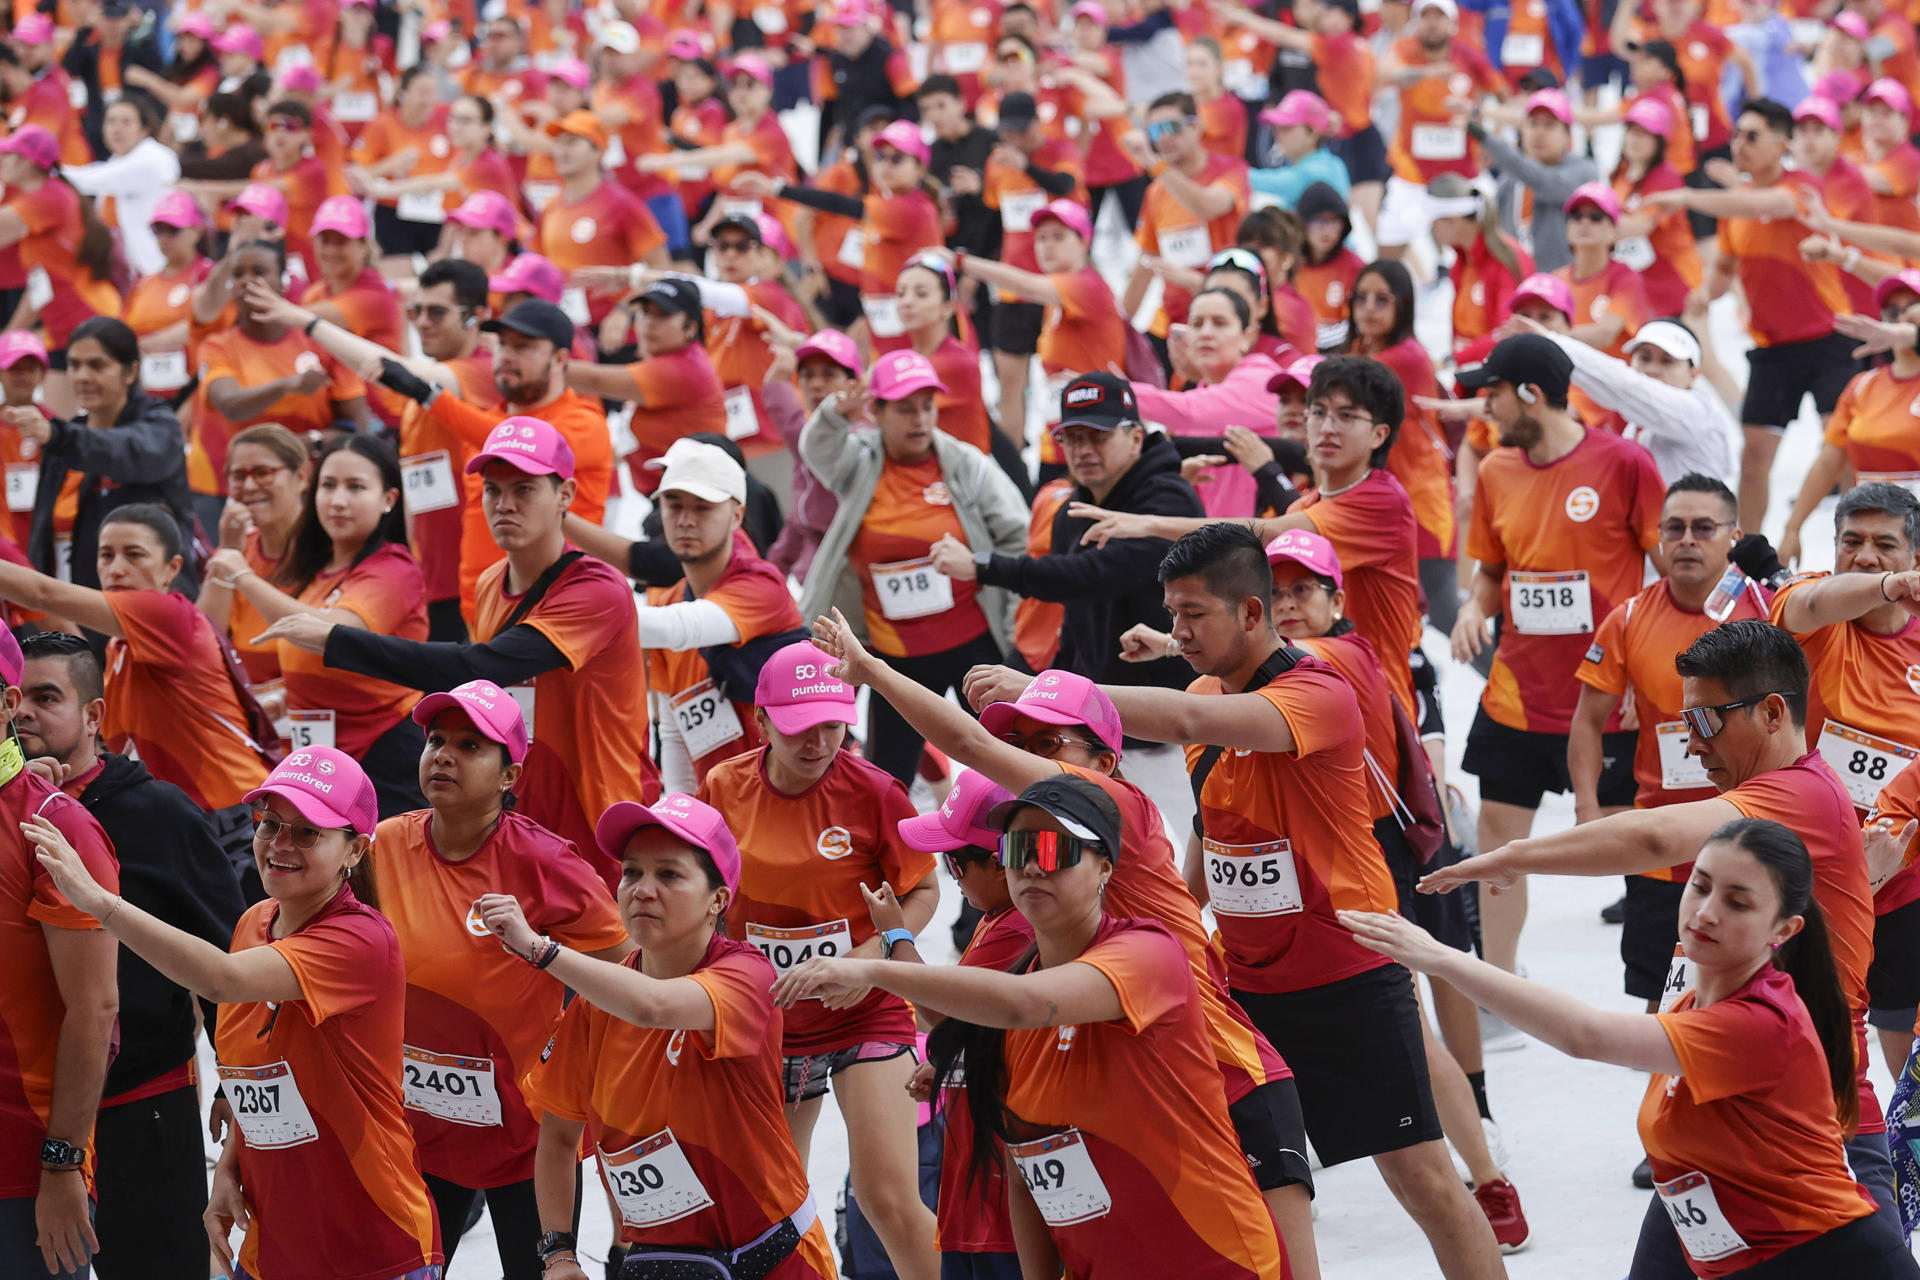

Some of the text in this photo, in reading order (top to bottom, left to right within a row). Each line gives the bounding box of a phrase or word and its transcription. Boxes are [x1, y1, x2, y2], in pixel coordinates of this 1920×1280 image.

[887, 573, 929, 595] 918
[1519, 588, 1574, 608] 3518
[679, 698, 716, 731] 259
[1848, 750, 1888, 781] 88
[1210, 858, 1281, 887] 3965
[404, 1064, 482, 1097] 2401
[234, 1084, 280, 1114] 2367
[609, 1163, 665, 1197] 230
